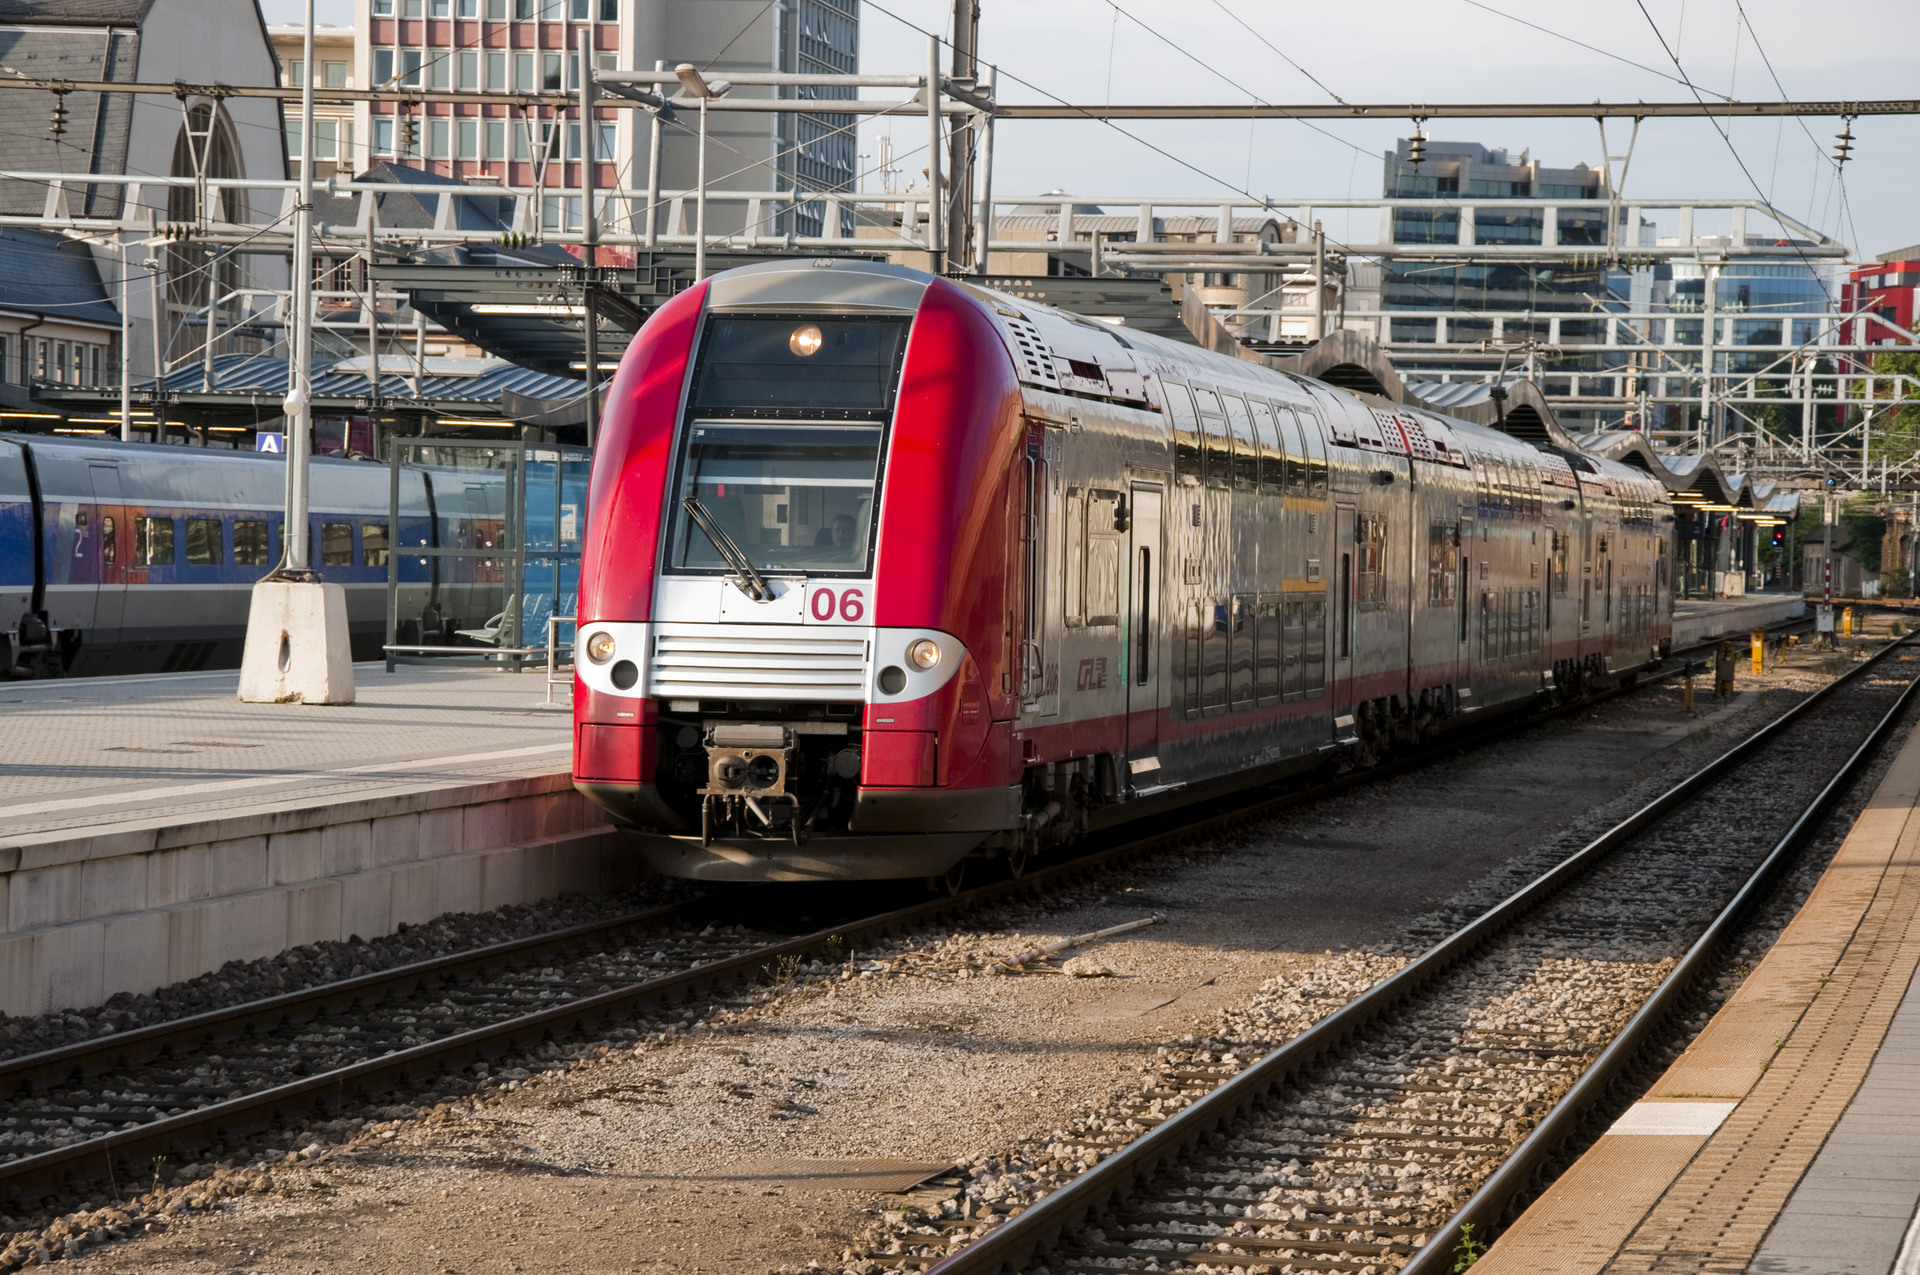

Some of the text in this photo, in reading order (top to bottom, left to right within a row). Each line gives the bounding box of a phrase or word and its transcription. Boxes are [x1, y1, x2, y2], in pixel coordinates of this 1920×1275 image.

[261, 435, 279, 453] A
[75, 529, 83, 557] 2
[811, 587, 864, 622] 06
